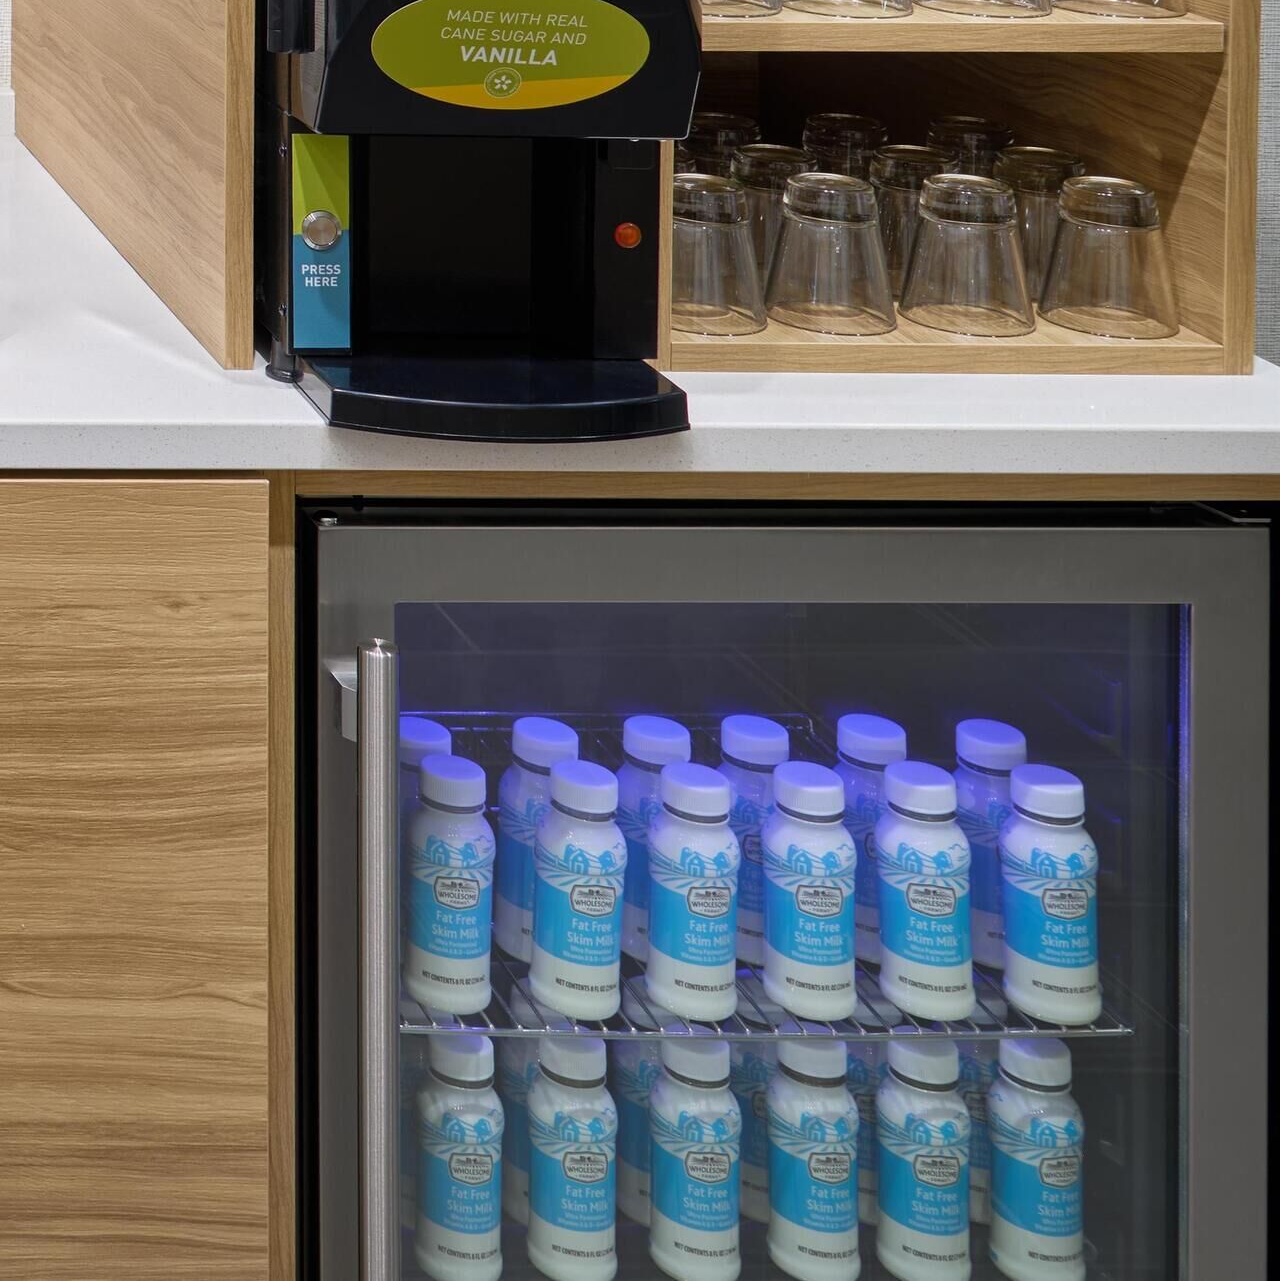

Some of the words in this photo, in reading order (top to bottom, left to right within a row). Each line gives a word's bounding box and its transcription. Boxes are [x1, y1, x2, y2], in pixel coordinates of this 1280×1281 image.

[447, 9, 495, 23] MADE
[500, 12, 541, 25] WITH
[546, 14, 588, 27] REAL
[441, 27, 487, 41] CANE
[491, 29, 546, 43] SUGAR
[551, 33, 587, 45] AND
[461, 46, 557, 66] VANILLA
[302, 265, 341, 274] PRESS
[305, 277, 338, 286] HERE
[439, 891, 477, 900] WHOLESOME
[575, 899, 613, 907] WHOLESOME
[911, 897, 952, 908] WHOLESOME
[436, 910, 453, 923] Fat
[456, 914, 477, 925] Free
[432, 924, 457, 938] Skim
[572, 918, 588, 930] Fat
[592, 921, 612, 932] Free
[689, 920, 706, 932] Fat
[709, 923, 728, 933] Free
[800, 919, 816, 931] Fat
[821, 922, 840, 932] Free
[910, 917, 928, 930] Fat
[931, 921, 954, 932] Free
[1045, 921, 1064, 934] Fat
[1067, 924, 1087, 934] Free
[568, 931, 593, 945] Skim
[684, 933, 710, 946] Skim
[795, 931, 821, 945] Skim
[906, 930, 933, 946] Skim
[937, 937, 958, 946] Milk
[1041, 934, 1069, 948] Skim
[454, 1167, 489, 1175] WHOLESOME
[567, 1166, 604, 1174] WHOLESOME
[690, 1166, 727, 1174] WHOLESOME
[451, 1186, 468, 1198] Fat
[471, 1190, 489, 1199] Free
[566, 1185, 582, 1197] Fat
[586, 1188, 605, 1198] Free
[688, 1185, 704, 1197] Fat
[708, 1187, 728, 1198] Free
[811, 1186, 827, 1198] Fat
[916, 1188, 933, 1201] Fat
[448, 1200, 472, 1213] Skim
[561, 1199, 587, 1212] Skim
[684, 1197, 709, 1211] Skim
[807, 1199, 833, 1213] Skim
[912, 1201, 939, 1215] Skim
